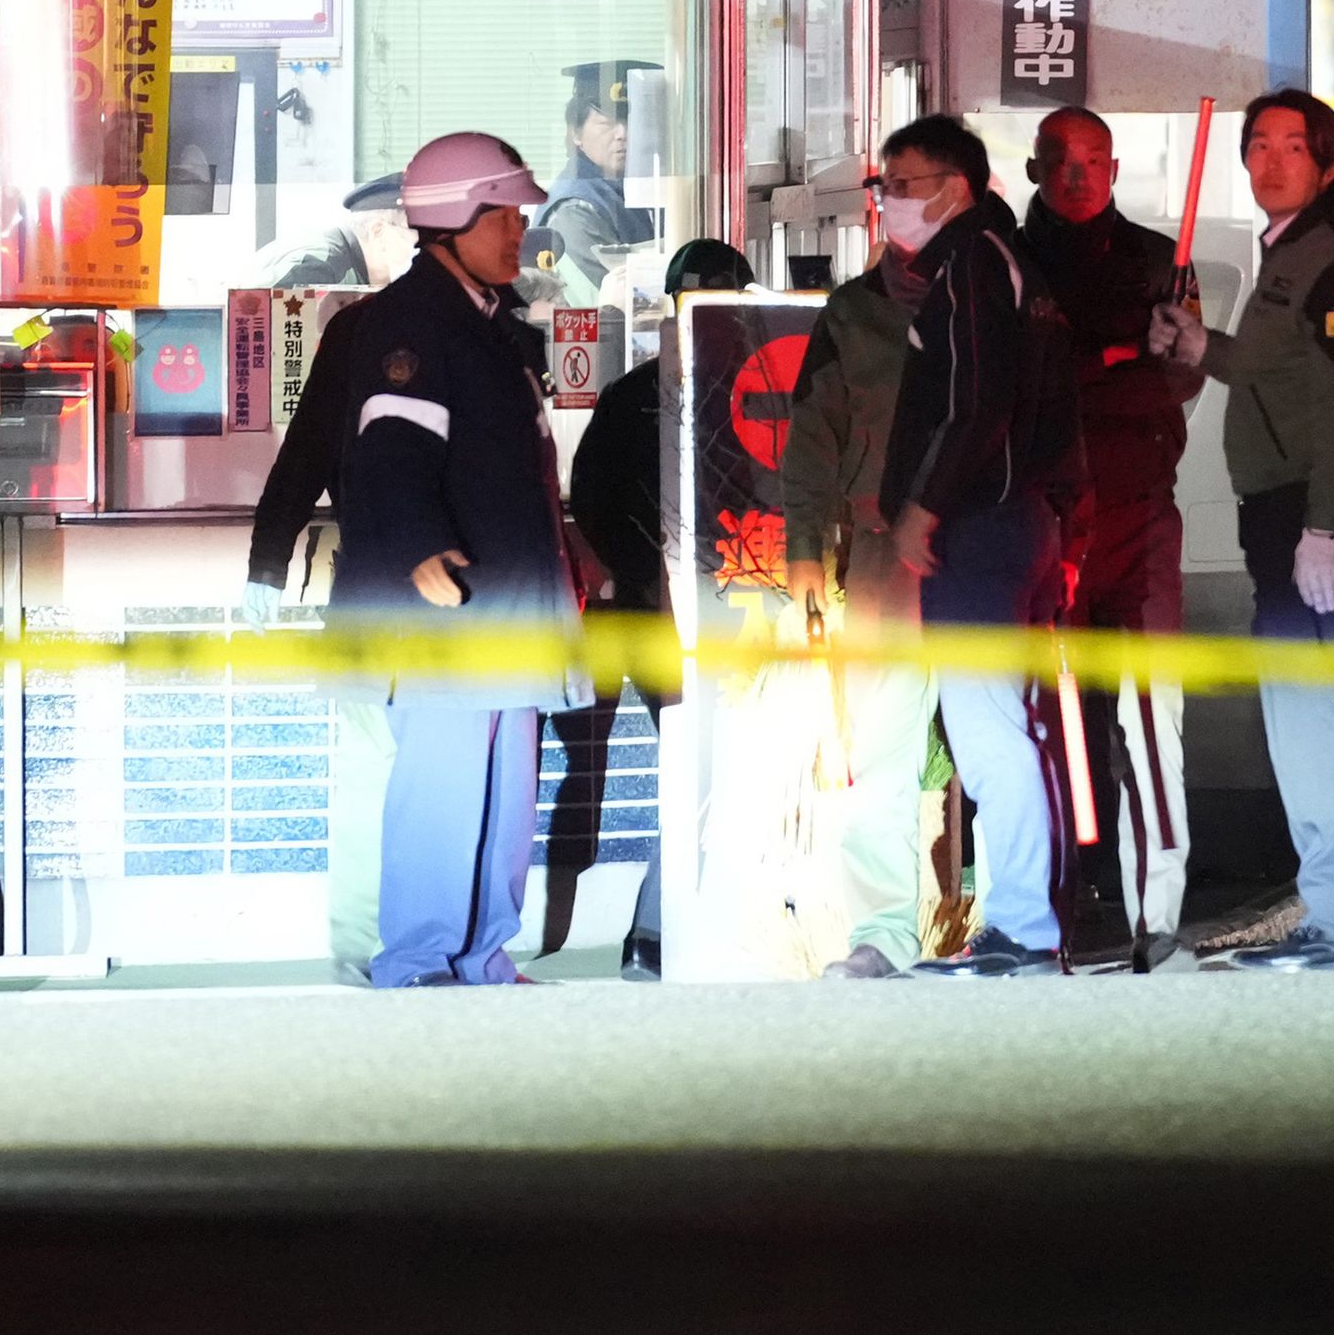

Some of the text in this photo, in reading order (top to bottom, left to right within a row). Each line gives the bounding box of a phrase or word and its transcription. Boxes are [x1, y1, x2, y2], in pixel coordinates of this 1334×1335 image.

[253, 318, 265, 368] 三島地区
[555, 311, 597, 329] ポケット手
[283, 320, 303, 416] 特別警戒中
